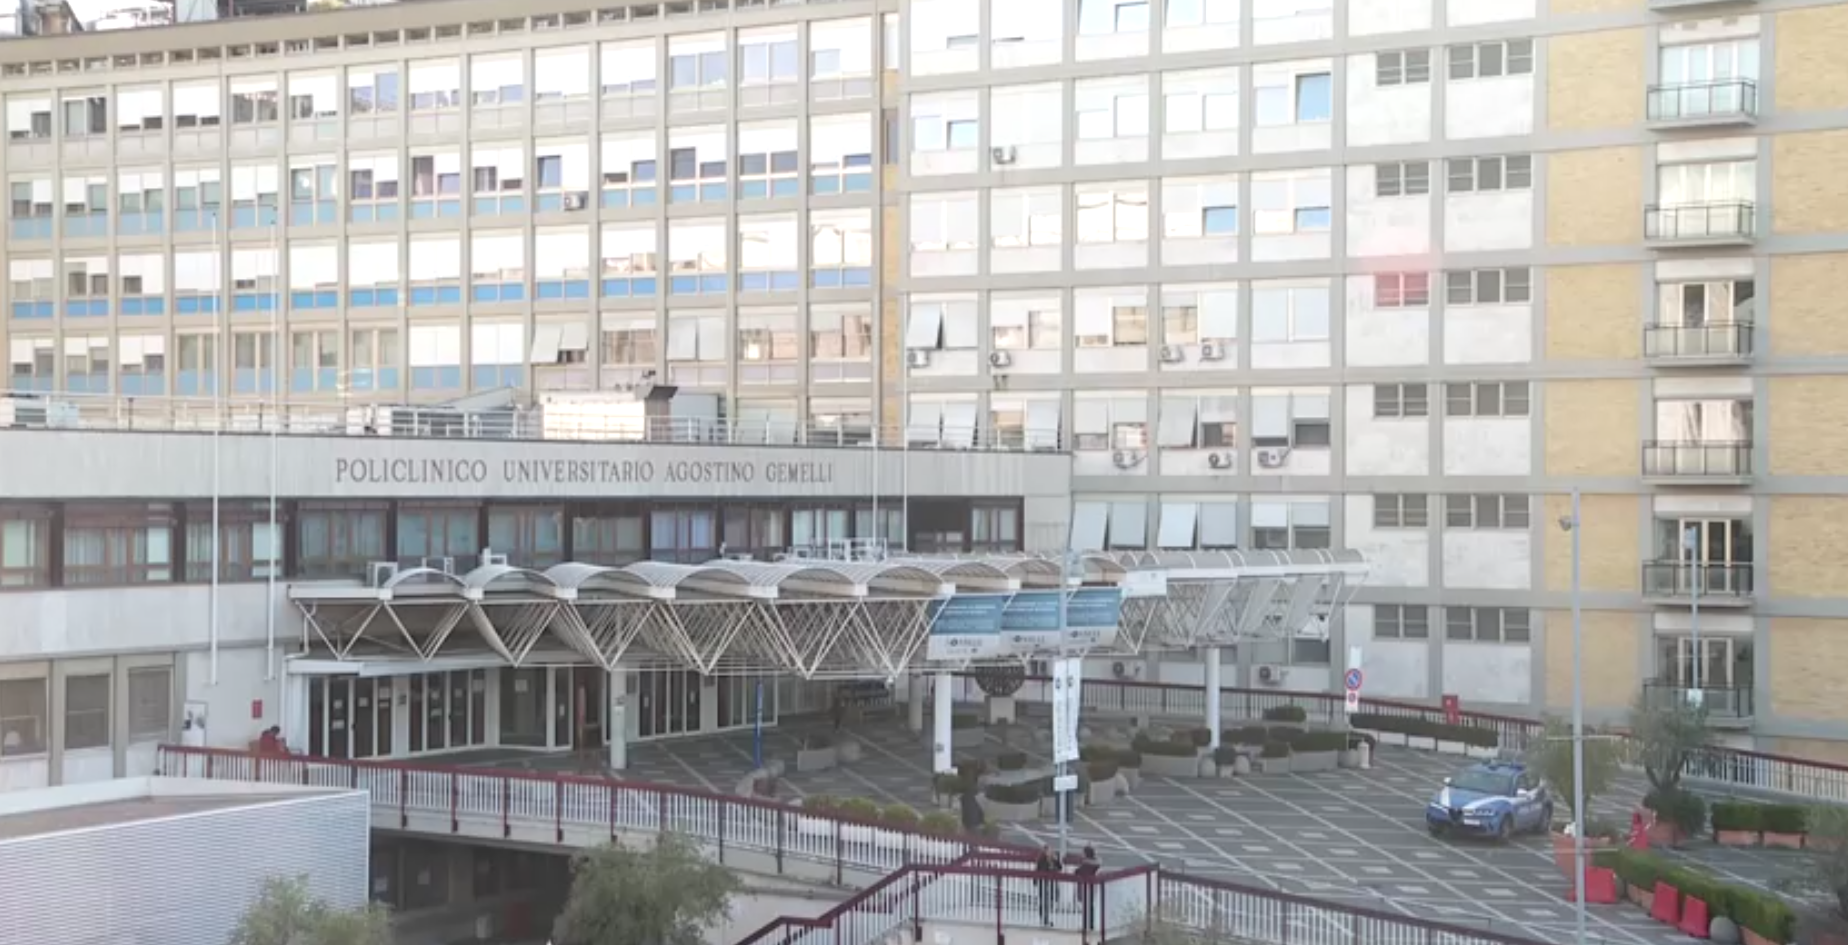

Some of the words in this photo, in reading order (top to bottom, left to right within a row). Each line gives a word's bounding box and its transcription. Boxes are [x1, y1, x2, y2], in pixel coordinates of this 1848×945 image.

[336, 458, 487, 482] POLICLINICO
[503, 459, 654, 482] UNIVERSITARIO
[664, 460, 754, 482] AGOSTINO
[766, 462, 834, 483] GEMELLI
